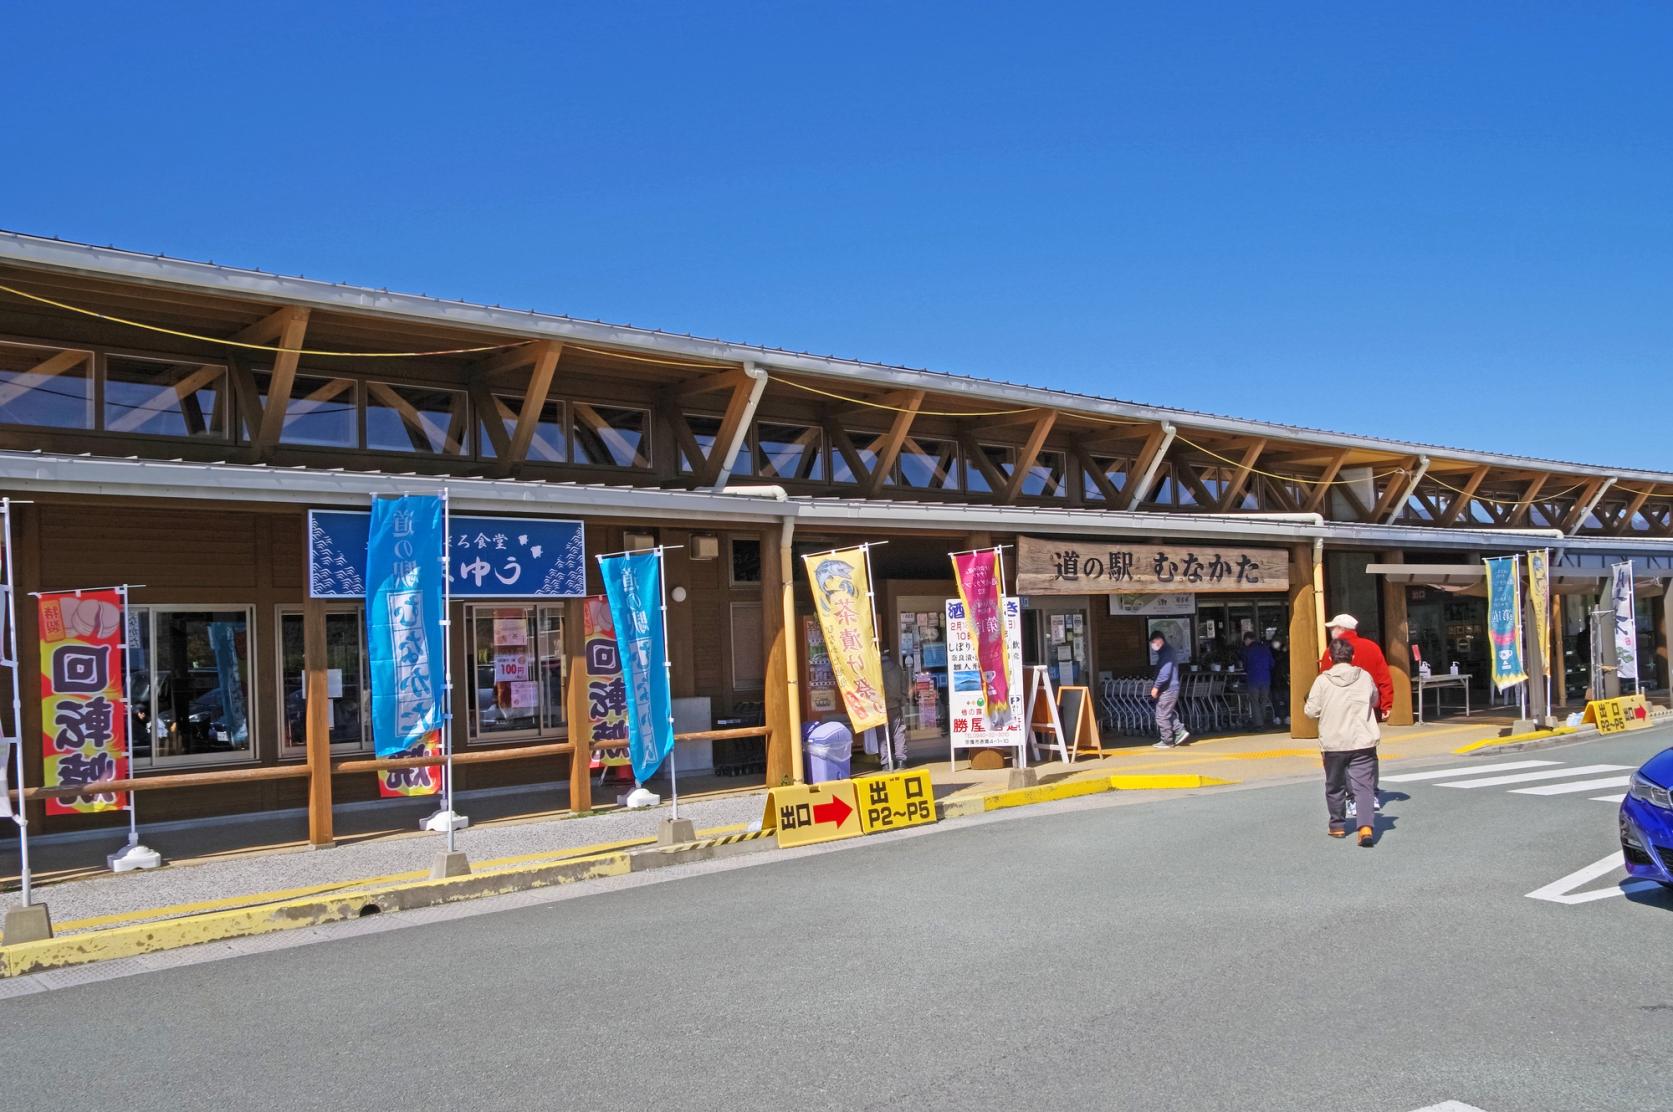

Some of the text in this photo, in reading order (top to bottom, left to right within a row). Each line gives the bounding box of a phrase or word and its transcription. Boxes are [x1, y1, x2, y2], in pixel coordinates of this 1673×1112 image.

[1054, 551, 1260, 583] 道の駅 むなかた
[1599, 702, 1619, 718] 出口
[869, 776, 924, 806] 出口
[781, 803, 811, 830] 出口
